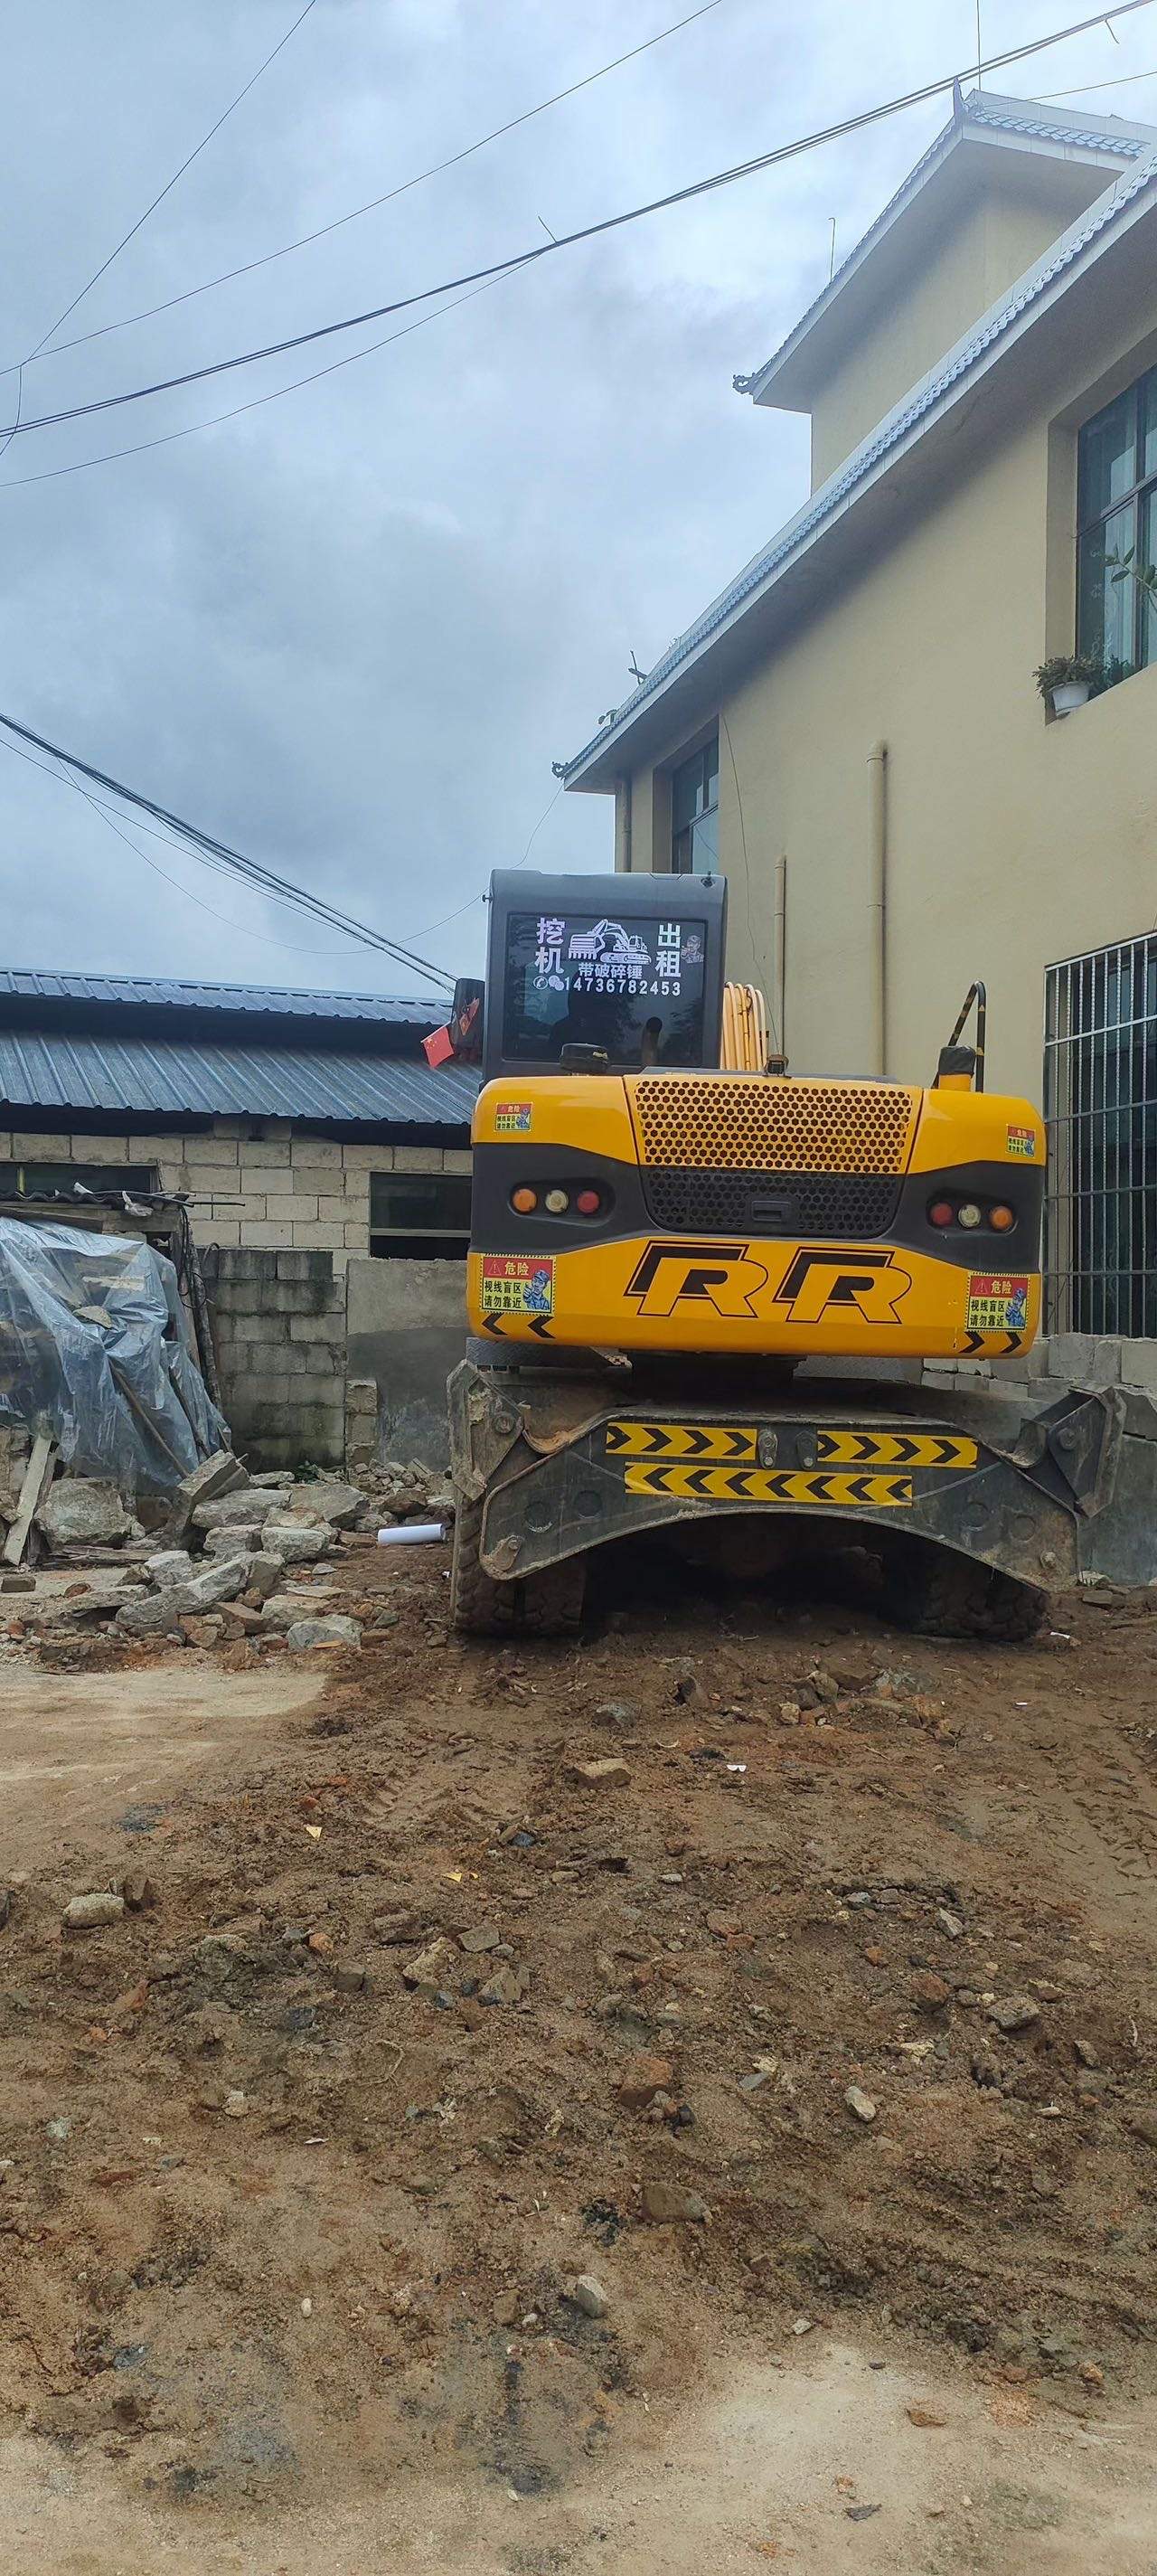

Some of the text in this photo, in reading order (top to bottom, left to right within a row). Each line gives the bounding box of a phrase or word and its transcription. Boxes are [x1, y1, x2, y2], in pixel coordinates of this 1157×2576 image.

[535, 918, 566, 974] 挖机
[655, 923, 681, 977] 出租
[578, 963, 643, 979] 带破碎锤
[565, 977, 681, 996] 14736782453
[504, 1261, 529, 1276] 危险
[484, 1280, 522, 1294] 视线盲区
[991, 1280, 1012, 1294] 危险
[484, 1296, 522, 1308] 请勿靠近
[971, 1299, 1005, 1312] 视线盲区
[970, 1314, 1004, 1326] 请勿靠近
